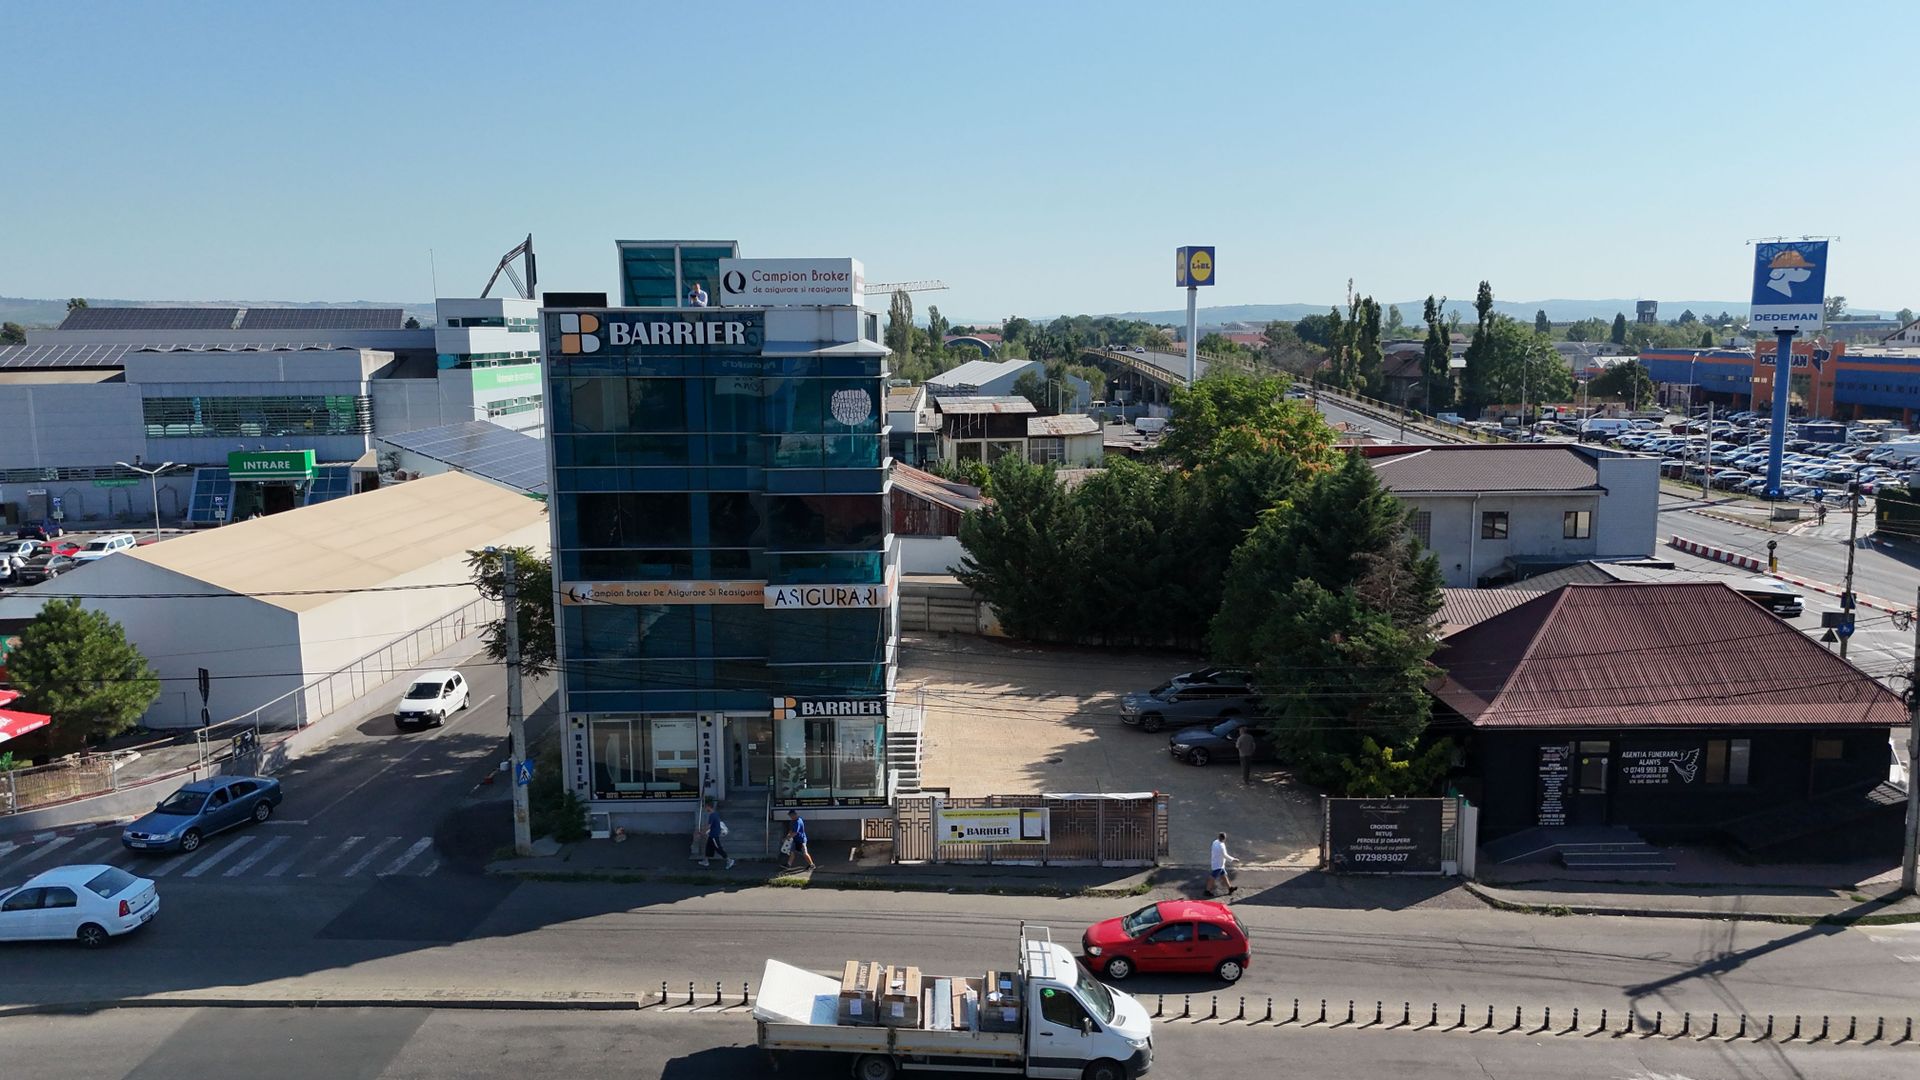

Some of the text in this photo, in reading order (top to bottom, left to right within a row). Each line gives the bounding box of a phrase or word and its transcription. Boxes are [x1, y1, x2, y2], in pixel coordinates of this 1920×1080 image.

[752, 269, 849, 283] Campion Broker
[765, 286, 798, 295] asigurare
[808, 286, 849, 295] reasigurare
[1754, 313, 1818, 321] DEDEMAN
[609, 321, 745, 346] BARRIER
[243, 460, 290, 469] INTRARE
[626, 588, 651, 597] Broker
[654, 588, 664, 597] De
[667, 588, 706, 599] Asigurare
[708, 588, 716, 597] Si
[775, 588, 877, 606] ASIGURARI
[802, 701, 882, 715] BARRIER
[575, 734, 584, 790] BARRIER
[967, 827, 1010, 836] BARRIER
